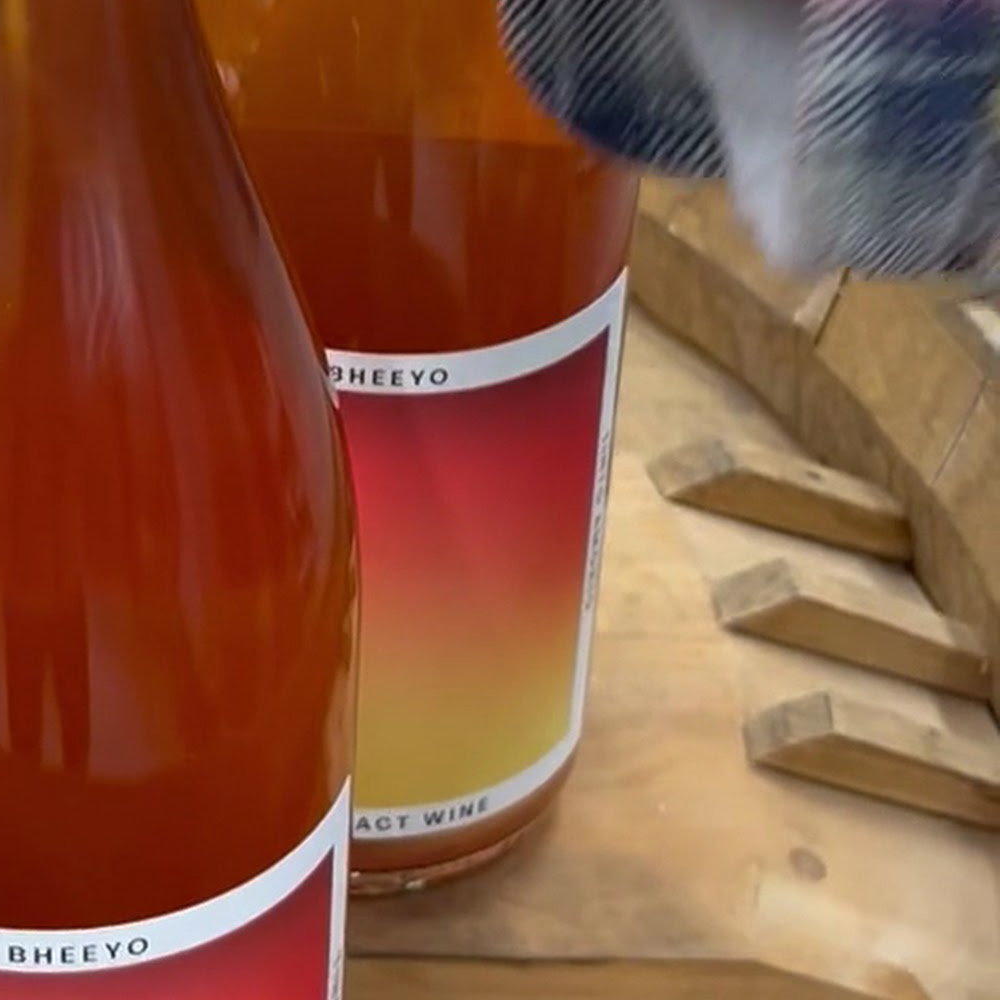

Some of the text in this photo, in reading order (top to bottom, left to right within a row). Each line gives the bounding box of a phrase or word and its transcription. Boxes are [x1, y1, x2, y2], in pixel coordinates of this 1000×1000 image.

[330, 365, 449, 387] BHEEYO
[423, 796, 489, 826] WINE
[8, 937, 150, 965] BHEEYO
